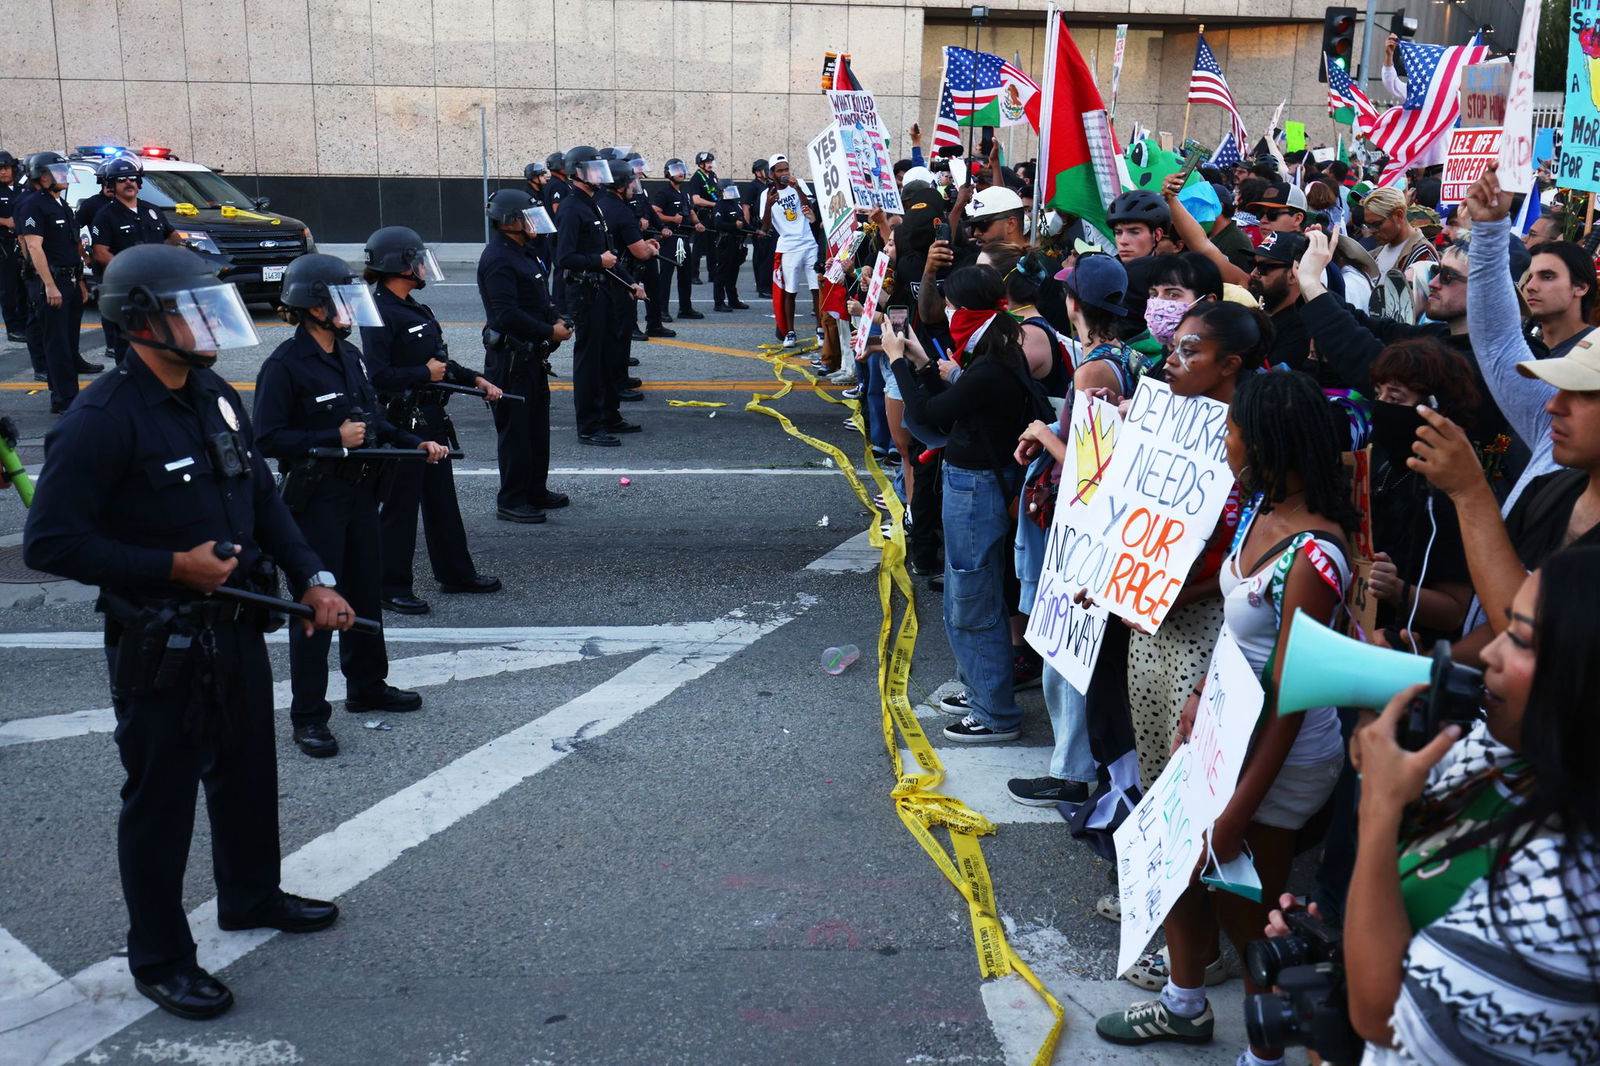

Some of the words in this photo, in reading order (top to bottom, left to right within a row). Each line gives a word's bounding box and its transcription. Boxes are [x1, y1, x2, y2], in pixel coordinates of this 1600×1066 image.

[1571, 73, 1580, 93] A
[830, 94, 851, 112] WHAT
[851, 94, 874, 113] KILLED
[1467, 94, 1486, 119] STOP
[1472, 134, 1492, 153] OFF
[1571, 116, 1600, 146] MOR
[814, 130, 837, 164] YES
[825, 160, 831, 169] ON
[1560, 152, 1583, 178] POR
[823, 165, 839, 196] 50
[1443, 186, 1453, 199] GET
[1453, 186, 1458, 199] A
[777, 194, 796, 205] WHAT
[782, 201, 795, 210] THE
[854, 186, 869, 206] THE
[881, 191, 900, 210] AGE!
[1123, 444, 1214, 515] NEEDS
[1225, 488, 1239, 527] ICO
[1102, 496, 1184, 566] YOUR
[1030, 573, 1070, 658] King
[1066, 606, 1106, 668] WAY
[1137, 796, 1156, 841] ALL
[1147, 836, 1162, 878] THE
[980, 927, 990, 943] LINEA
[984, 951, 994, 968] POLICIA
